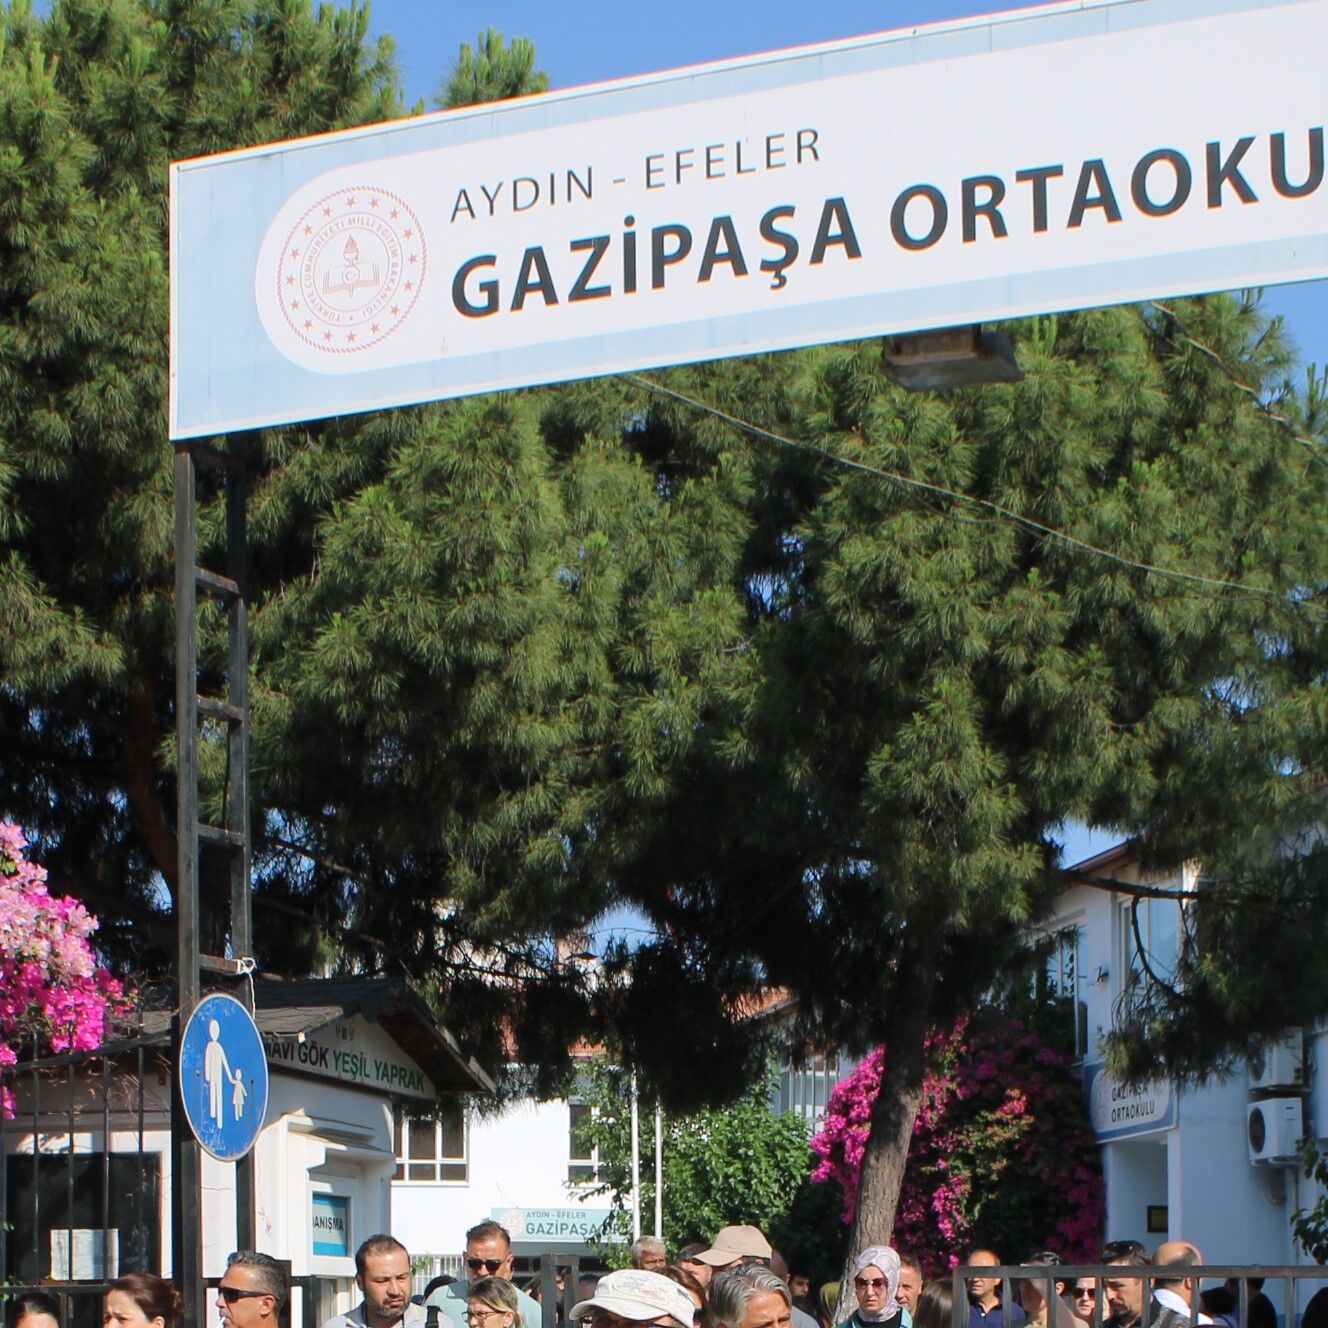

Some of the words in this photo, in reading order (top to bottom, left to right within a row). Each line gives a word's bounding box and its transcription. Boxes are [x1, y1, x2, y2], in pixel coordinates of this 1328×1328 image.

[450, 154, 594, 223] AYDIN
[643, 128, 822, 191] EFELER
[451, 195, 862, 320] GAZİPAŞA
[298, 1040, 329, 1069] GÖK
[332, 1047, 370, 1080] YEŞİL
[374, 1059, 425, 1093] YAPRAK
[1111, 1100, 1155, 1123] ORTAOKULU
[525, 1219, 597, 1236] GAZİPAŞA
[526, 1211, 550, 1219] AYDIN
[556, 1211, 587, 1219] EFELER
